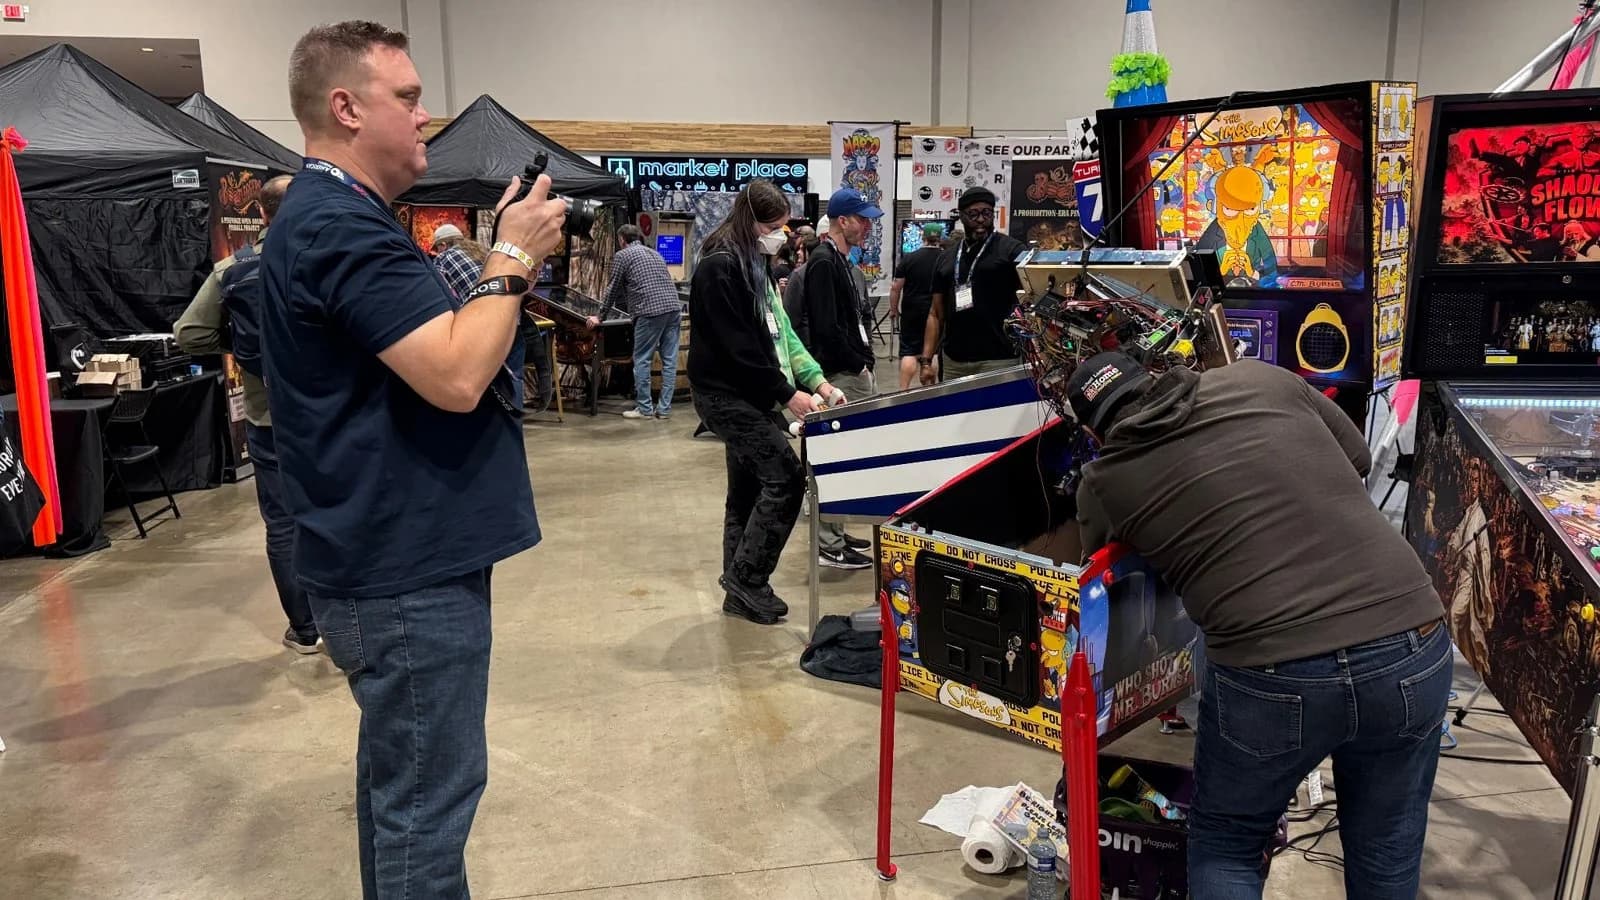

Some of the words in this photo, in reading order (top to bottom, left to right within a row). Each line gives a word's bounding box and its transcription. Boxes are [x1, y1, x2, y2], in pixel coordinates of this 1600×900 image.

[985, 145, 1009, 155] SEE
[1013, 146, 1041, 156] OUR
[638, 159, 728, 177] market
[735, 159, 806, 181] place
[926, 164, 943, 174] FAST
[1309, 281, 1340, 289] BURNS
[1090, 368, 1121, 389] Home
[879, 530, 909, 545] POLICE
[912, 538, 935, 551] LINE
[946, 545, 959, 556] DO
[962, 548, 980, 562] NOT
[984, 554, 1016, 570] CROSS
[1030, 565, 1072, 583] POLICE
[1056, 587, 1080, 606] LIN
[899, 663, 922, 678] LICE
[1115, 671, 1142, 699] WHO
[1021, 720, 1040, 735] NOT
